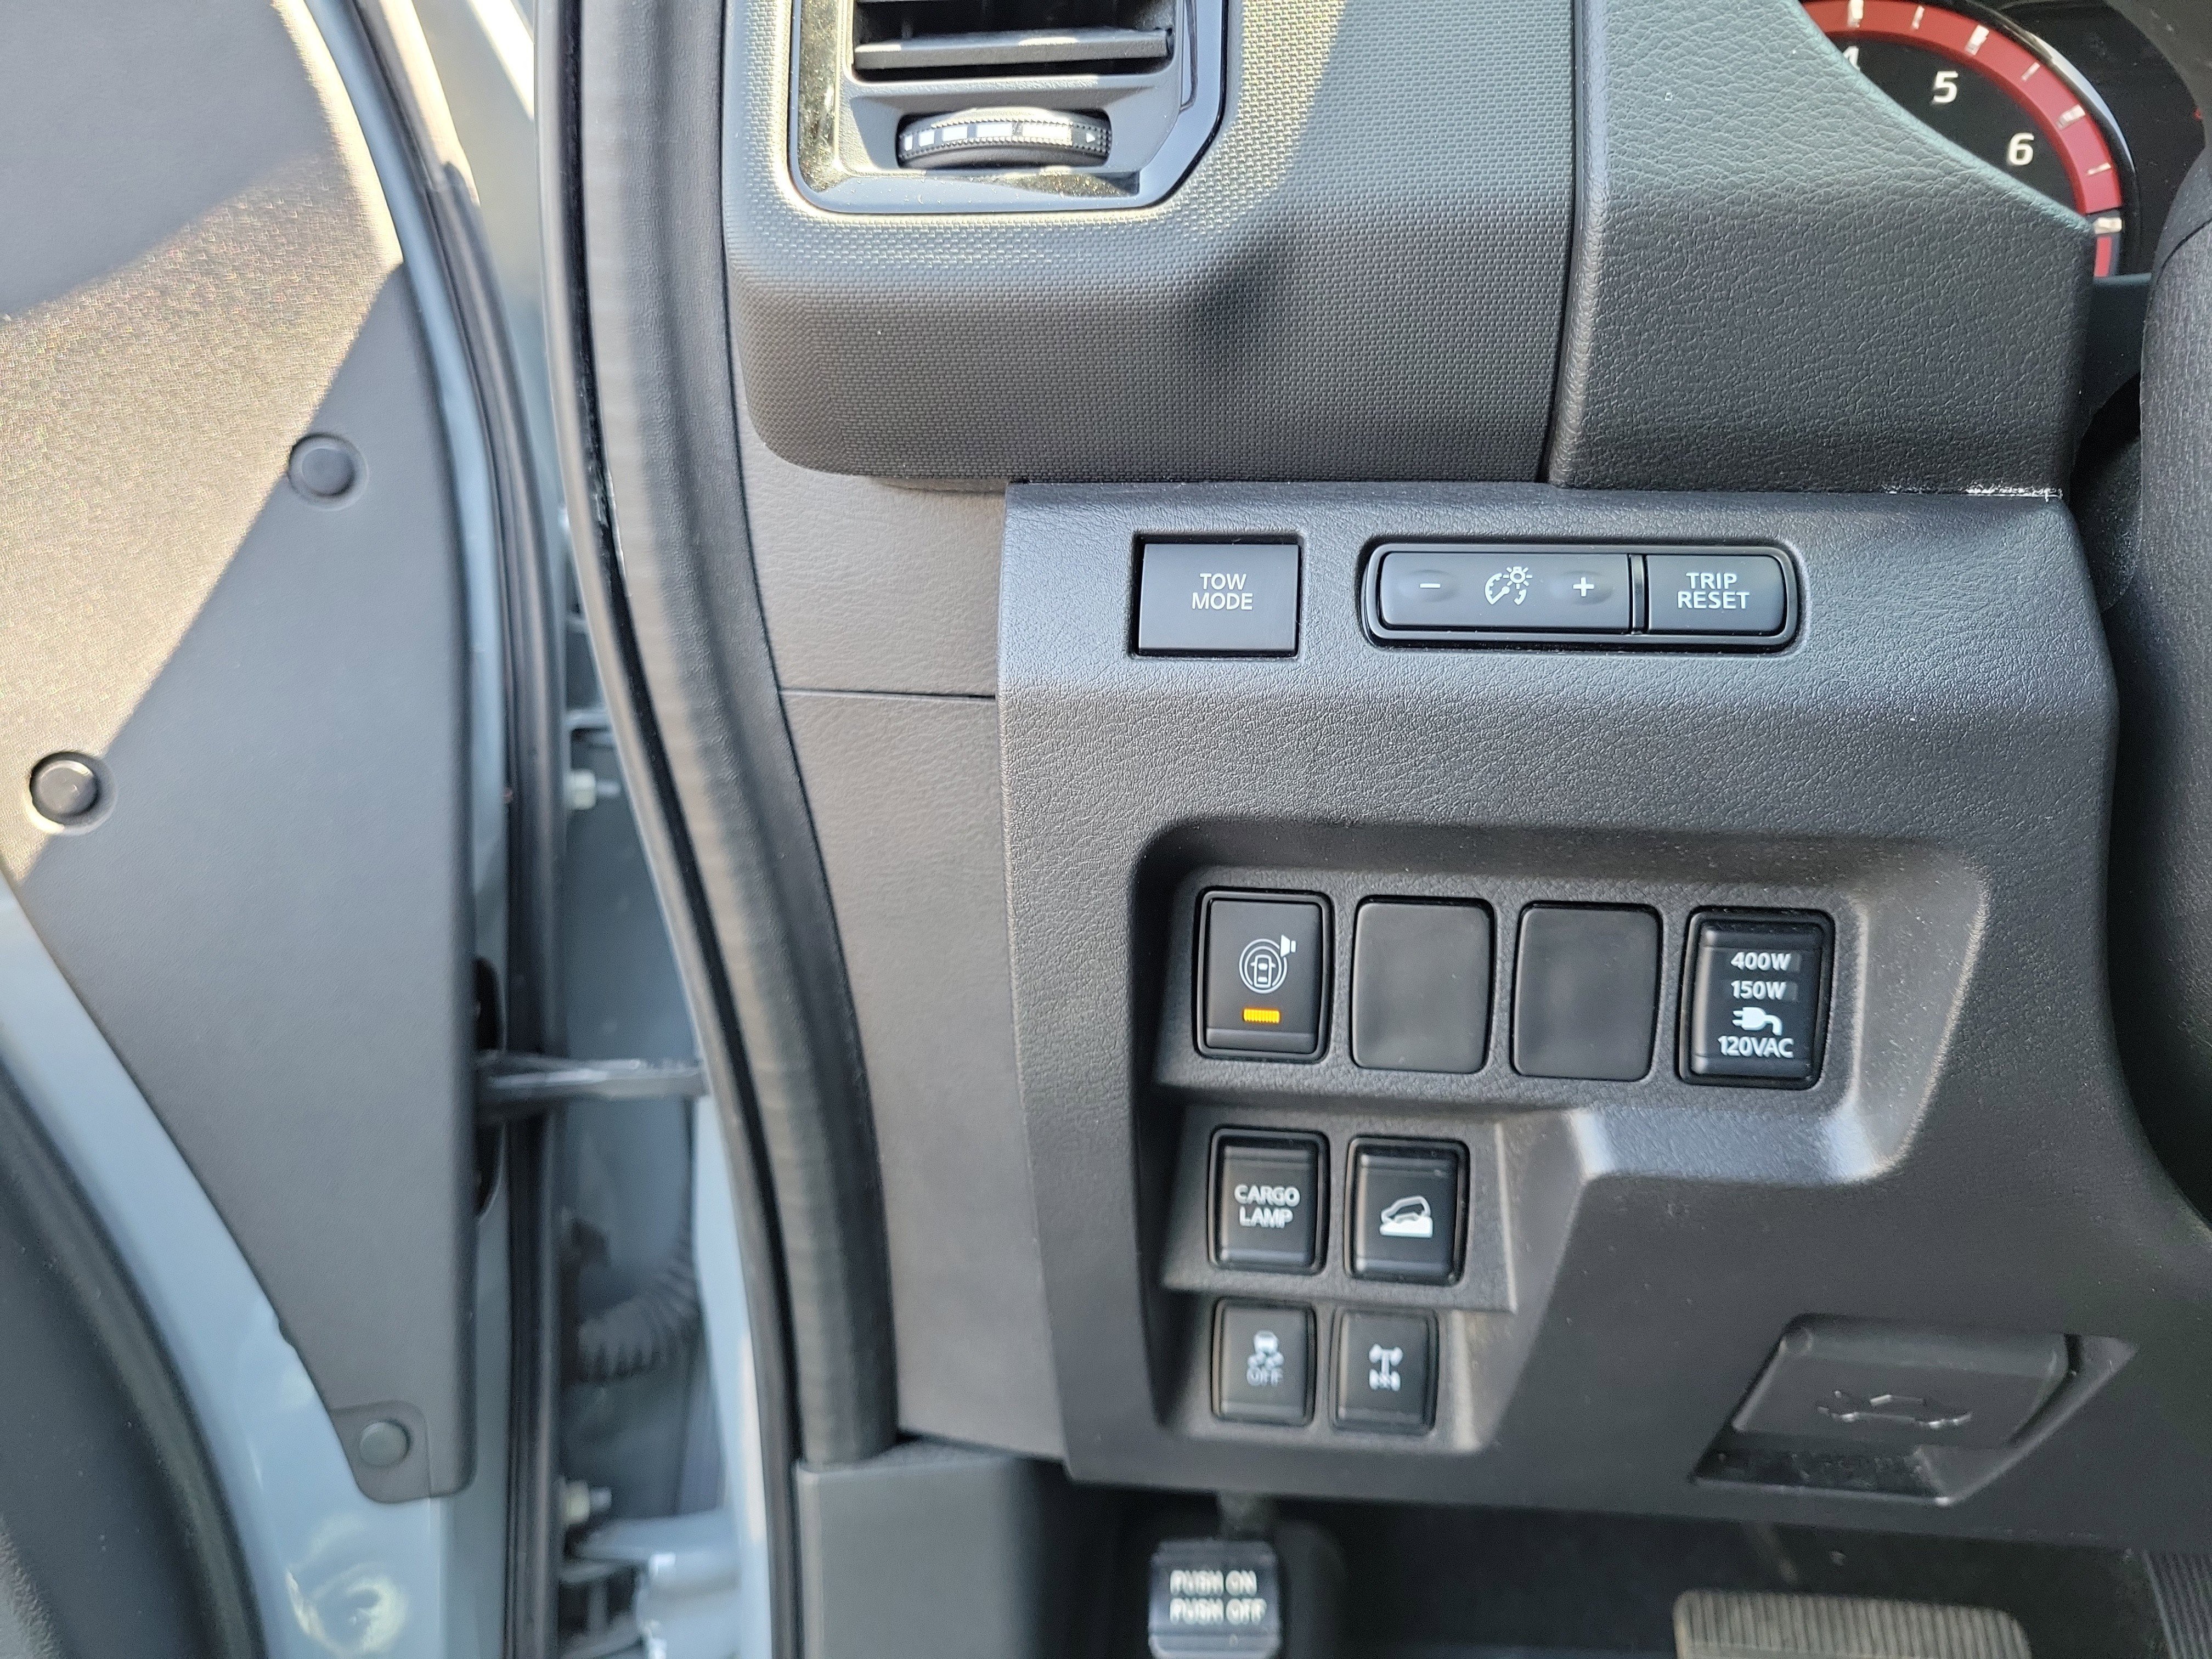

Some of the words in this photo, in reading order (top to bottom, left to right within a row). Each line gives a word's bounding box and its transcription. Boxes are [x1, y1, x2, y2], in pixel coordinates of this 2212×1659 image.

[1932, 71, 1958, 104] 5
[2006, 133, 2034, 166] 6
[1199, 573, 1247, 590] TOW
[1685, 572, 1737, 590] TRIP
[1192, 592, 1253, 610] MODE
[1677, 591, 1750, 610] RESET
[1730, 952, 1792, 971] 400W
[1731, 980, 1787, 1000] 150W
[1718, 1036, 1795, 1058] 120VAC
[1234, 1184, 1301, 1207] CARGO
[1238, 1206, 1294, 1229] LAMP
[1246, 1368, 1284, 1386] OFF
[1170, 1570, 1224, 1596] PUSH
[1225, 1570, 1257, 1596] ON
[1170, 1598, 1224, 1625] PUSH
[1226, 1598, 1267, 1625] OFF
